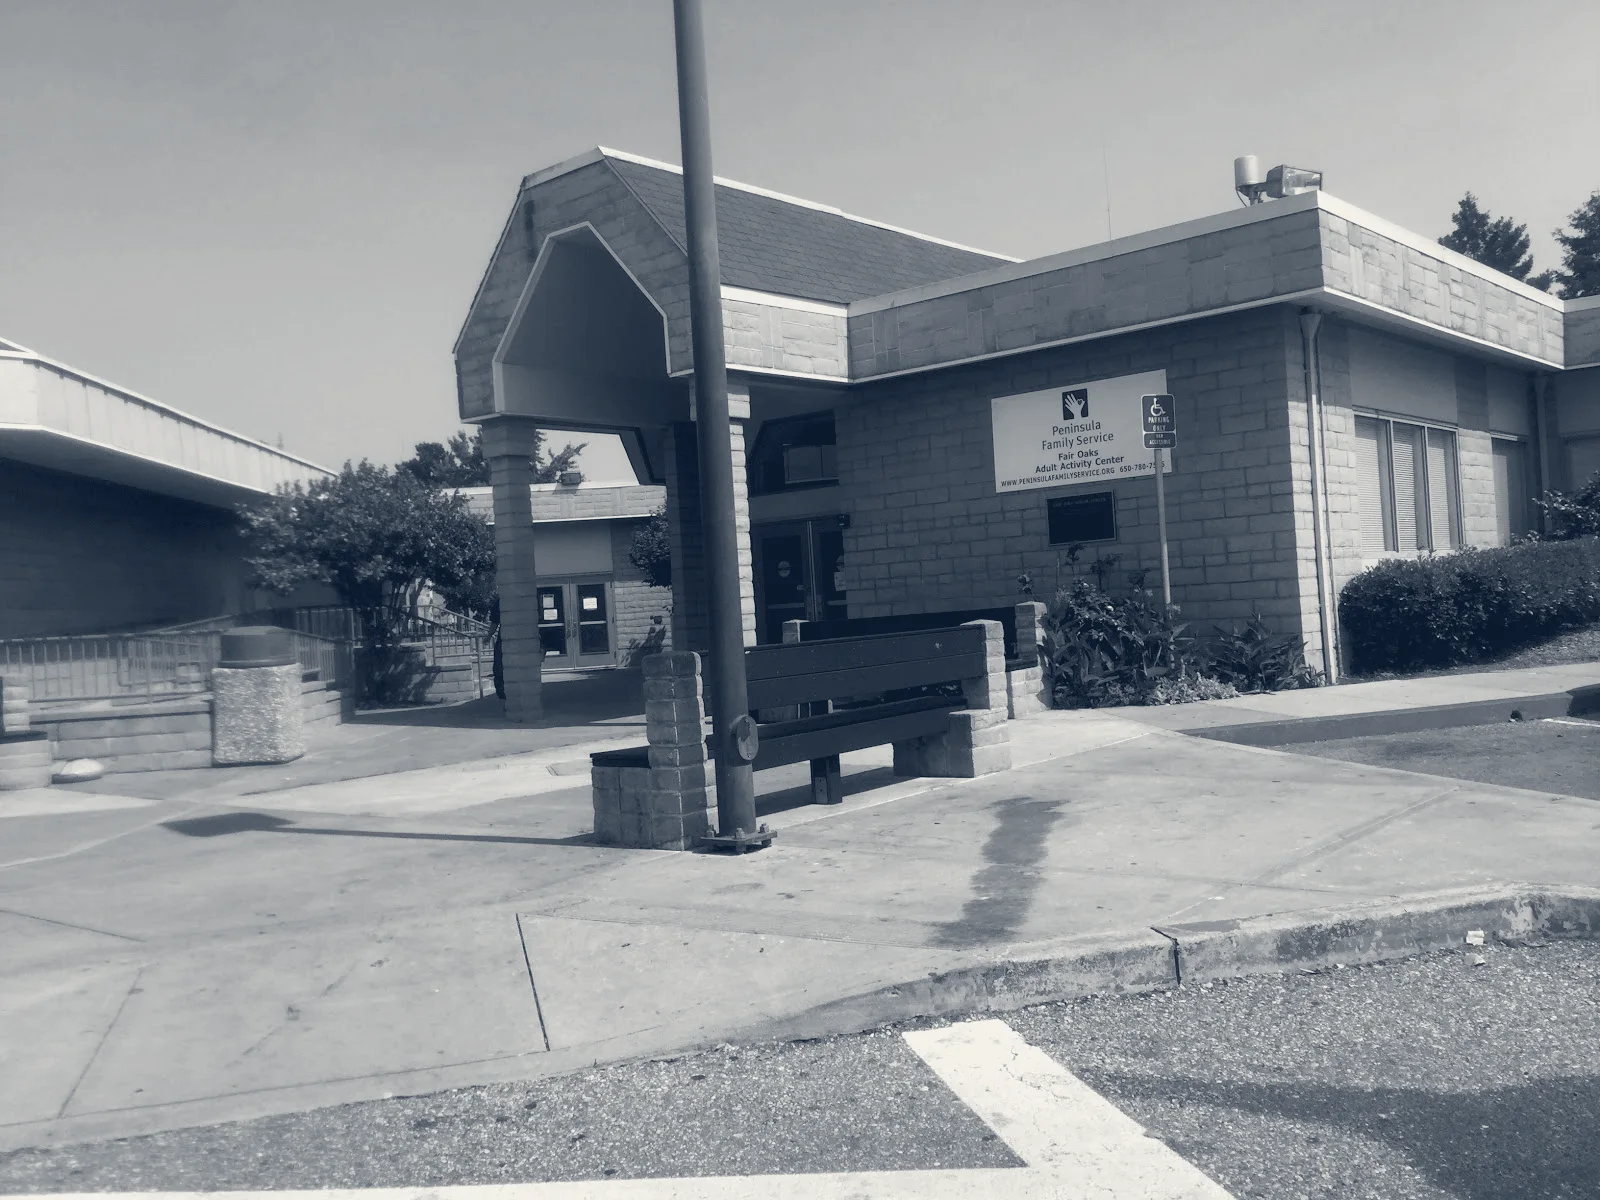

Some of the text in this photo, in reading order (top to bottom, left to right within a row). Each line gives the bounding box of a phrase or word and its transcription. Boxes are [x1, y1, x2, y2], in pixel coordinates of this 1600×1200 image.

[1052, 420, 1101, 436] Peninsula
[1148, 416, 1170, 424] PARKING
[1042, 432, 1114, 450] Family Service
[1058, 449, 1099, 461] Fair Oaks
[1035, 455, 1124, 473] Adult Activity Center
[1001, 467, 1115, 487] WWW.PENINSULAFAMILYSERVICE.ORG
